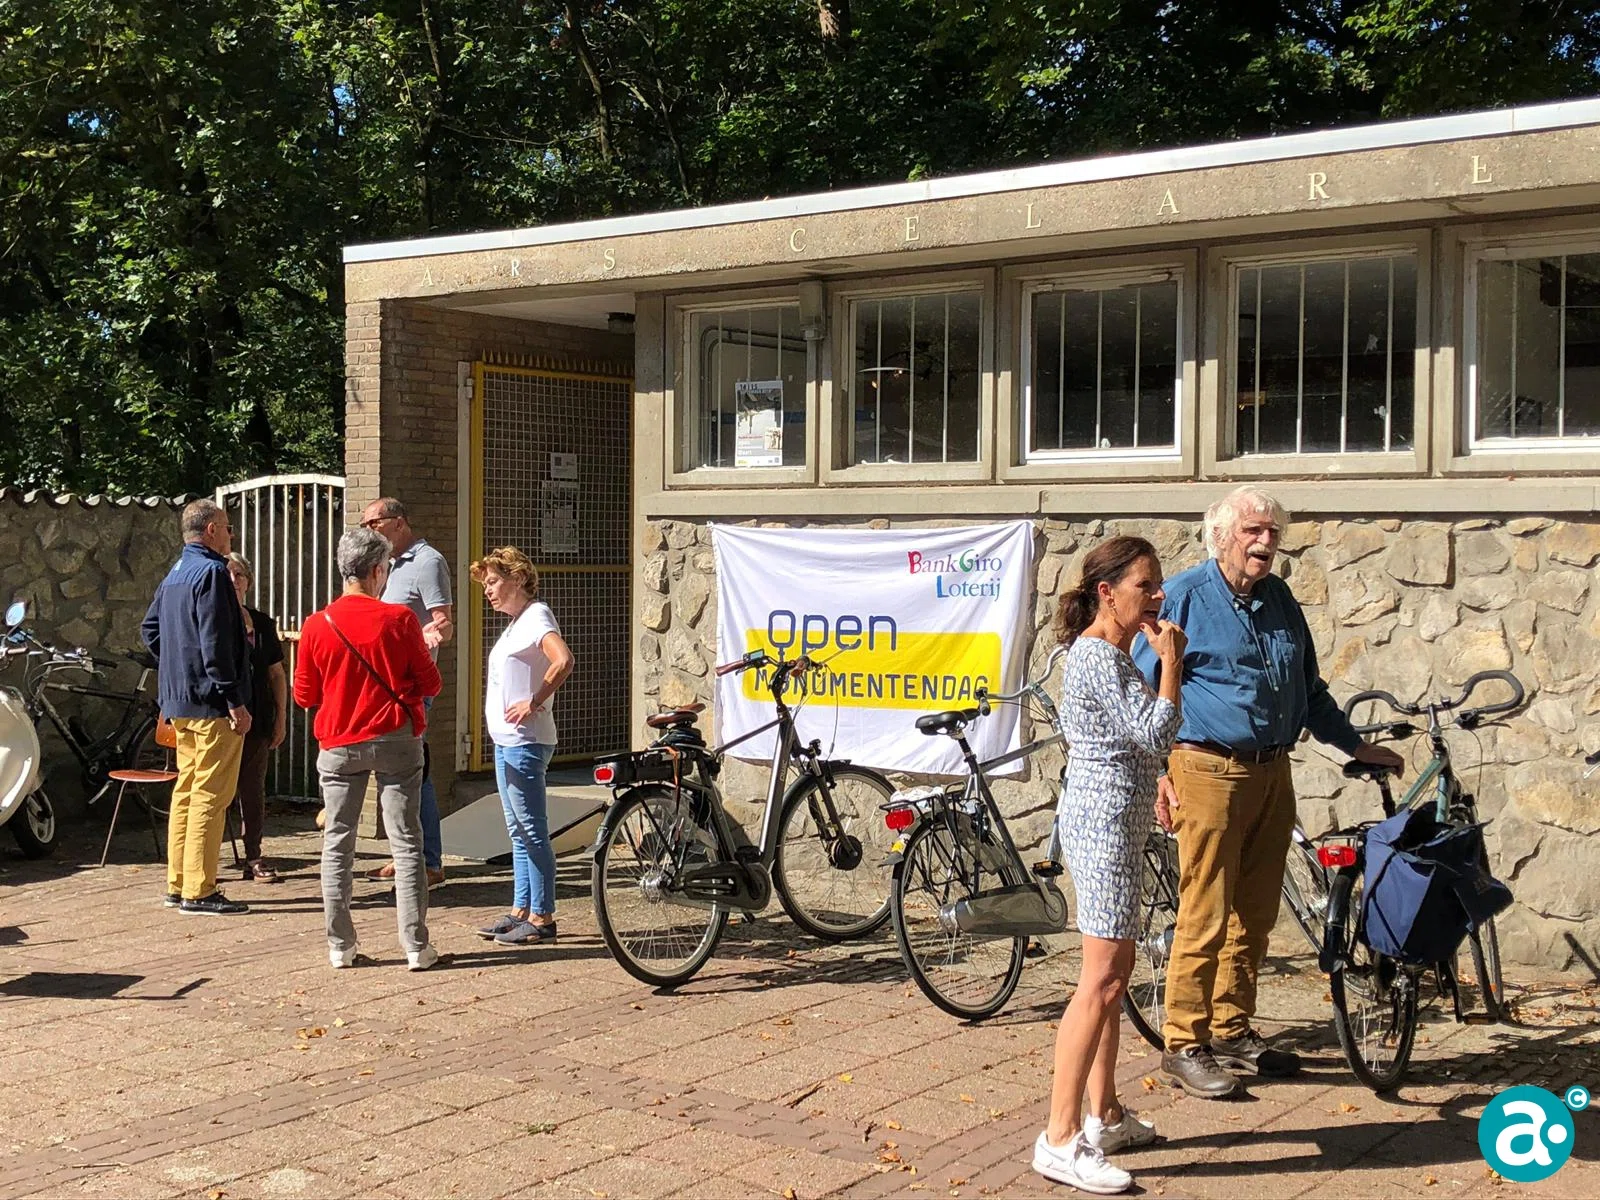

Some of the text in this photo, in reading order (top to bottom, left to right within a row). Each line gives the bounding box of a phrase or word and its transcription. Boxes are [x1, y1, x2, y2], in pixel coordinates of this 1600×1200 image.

[907, 549, 1002, 575] BankGiro
[936, 575, 1001, 601] Loterij
[768, 609, 897, 655] Open
